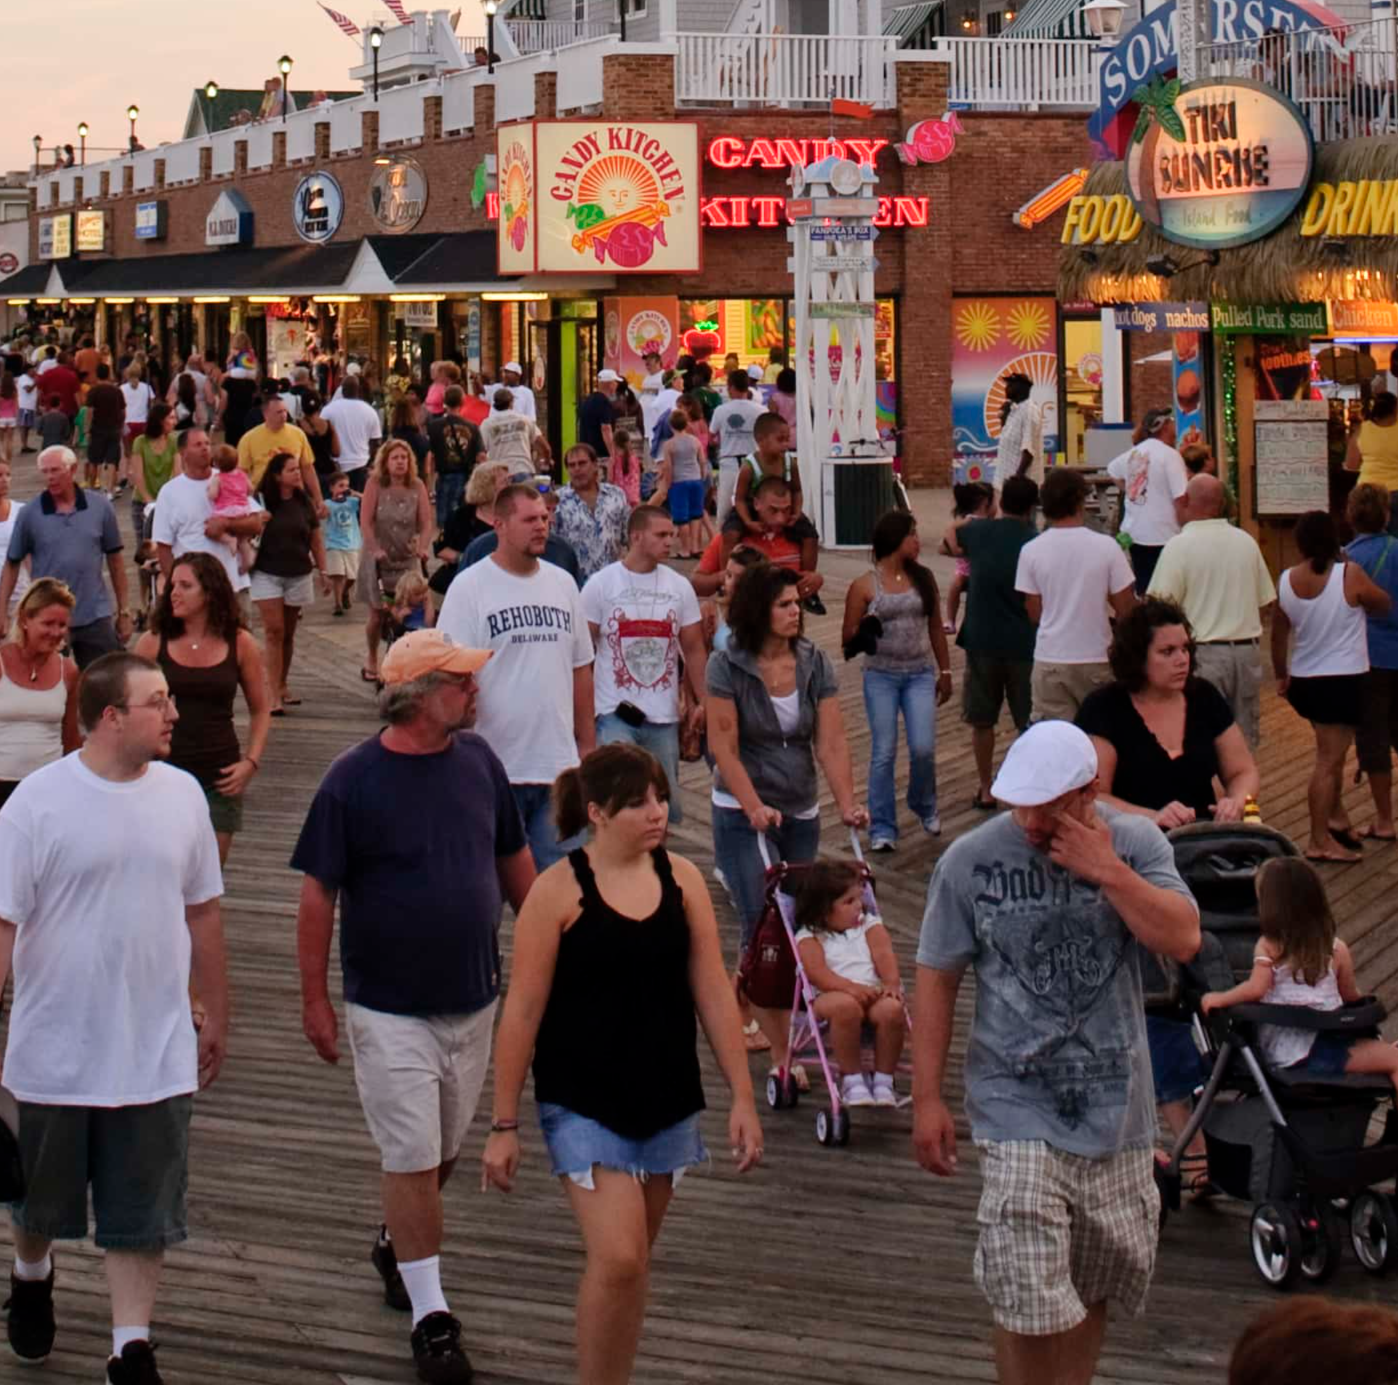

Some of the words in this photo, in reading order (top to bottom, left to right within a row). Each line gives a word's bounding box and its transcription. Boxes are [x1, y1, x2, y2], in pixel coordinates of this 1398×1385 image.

[1184, 101, 1237, 144] TIKI
[550, 131, 602, 201] CANDY
[607, 127, 686, 201] KITCHEN
[709, 138, 888, 168] CANDY
[1160, 145, 1269, 194] SUNRISE
[700, 196, 930, 228] KITEN
[1061, 194, 1144, 245] FOOD
[1131, 306, 1157, 333] dogs
[1165, 307, 1209, 328] nachos
[1212, 306, 1253, 329] Pulled
[1256, 305, 1286, 329] Pork
[1290, 306, 1325, 330] sand
[1333, 300, 1393, 329] Chicken
[487, 604, 572, 639] REHOBOTH
[511, 632, 559, 643] DELAWARE
